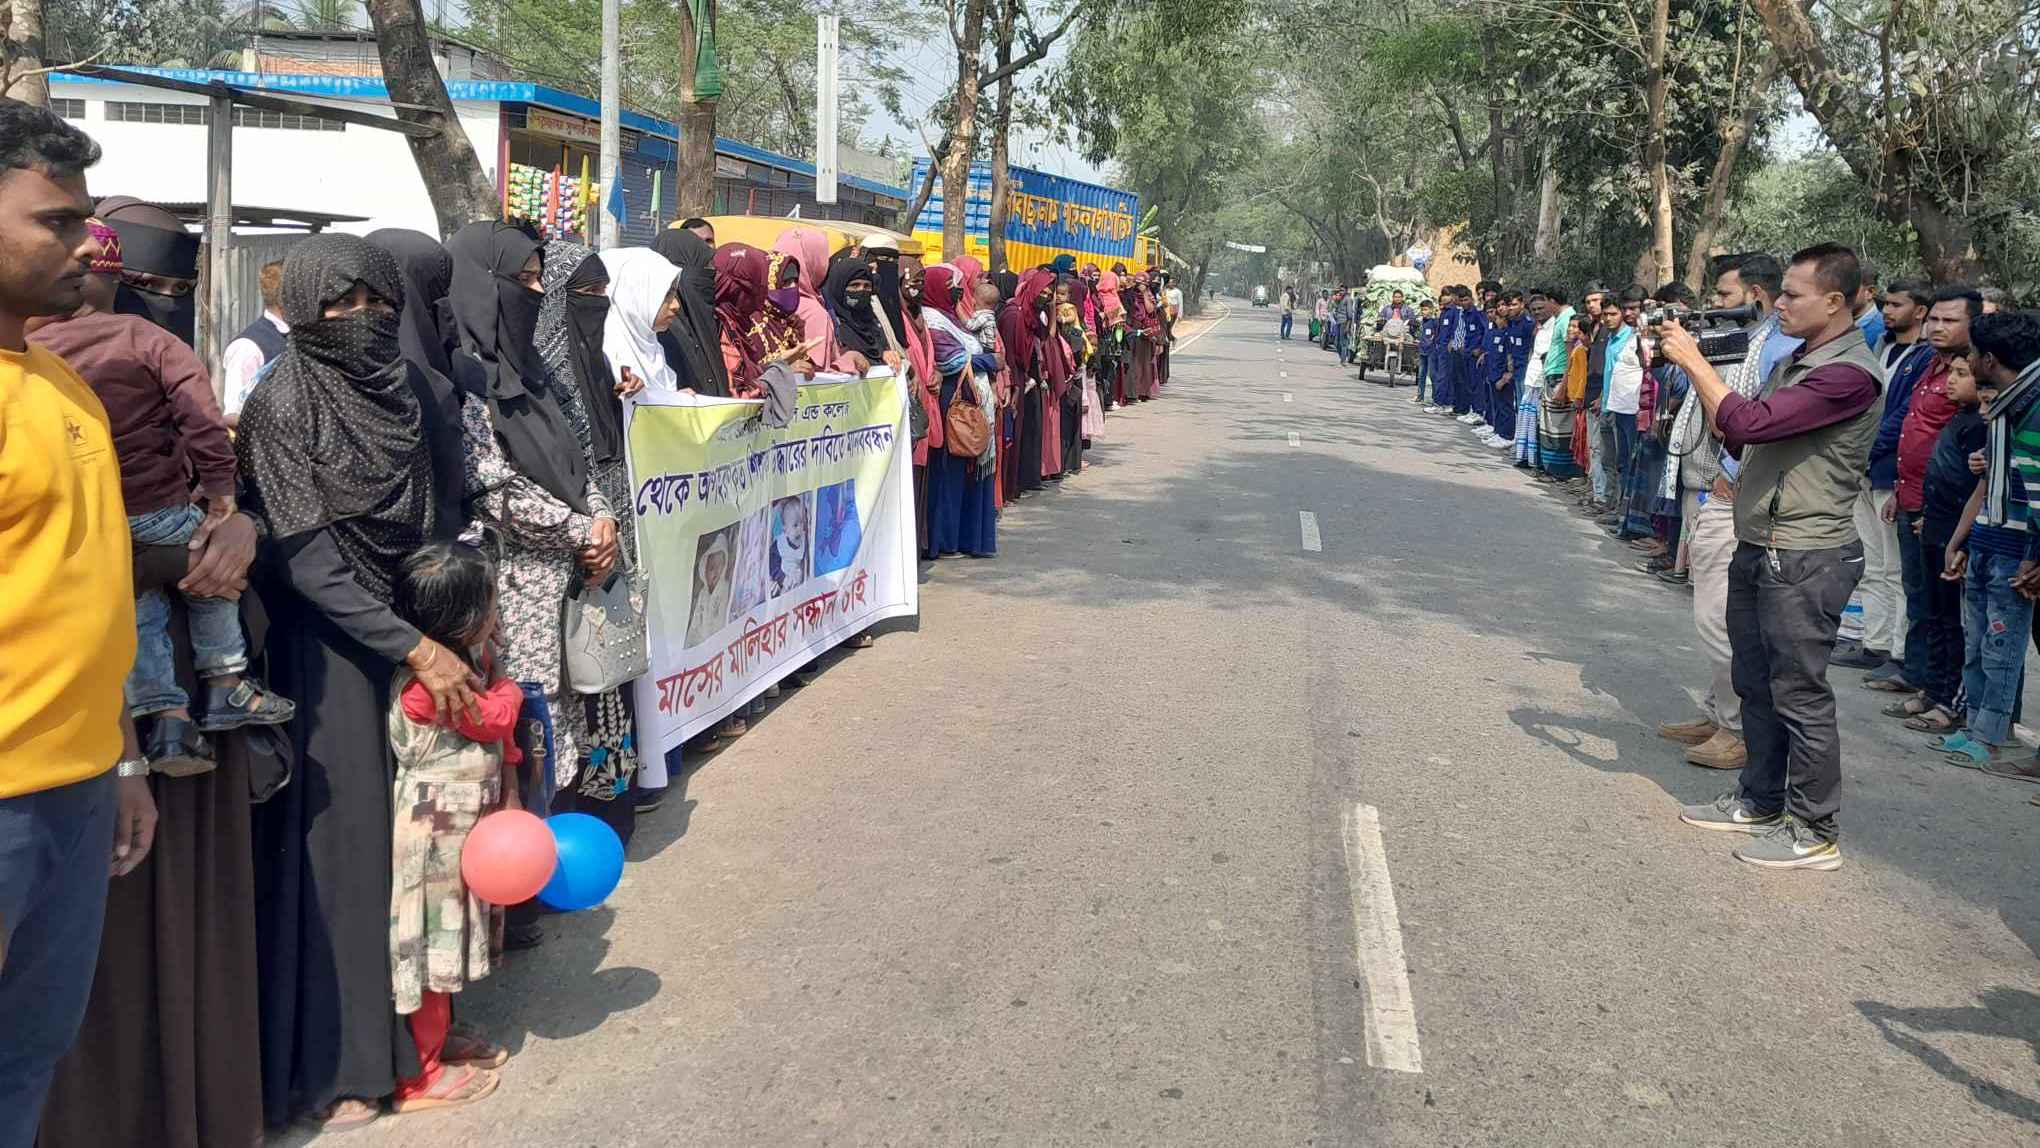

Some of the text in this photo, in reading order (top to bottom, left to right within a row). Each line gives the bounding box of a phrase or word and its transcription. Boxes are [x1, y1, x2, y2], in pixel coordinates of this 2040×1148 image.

[637, 472, 694, 516] থেকে
[810, 424, 846, 467] দাবিতে
[656, 651, 725, 716] মাসের
[728, 612, 789, 678] মালিহার
[792, 589, 840, 637] সন্ধান
